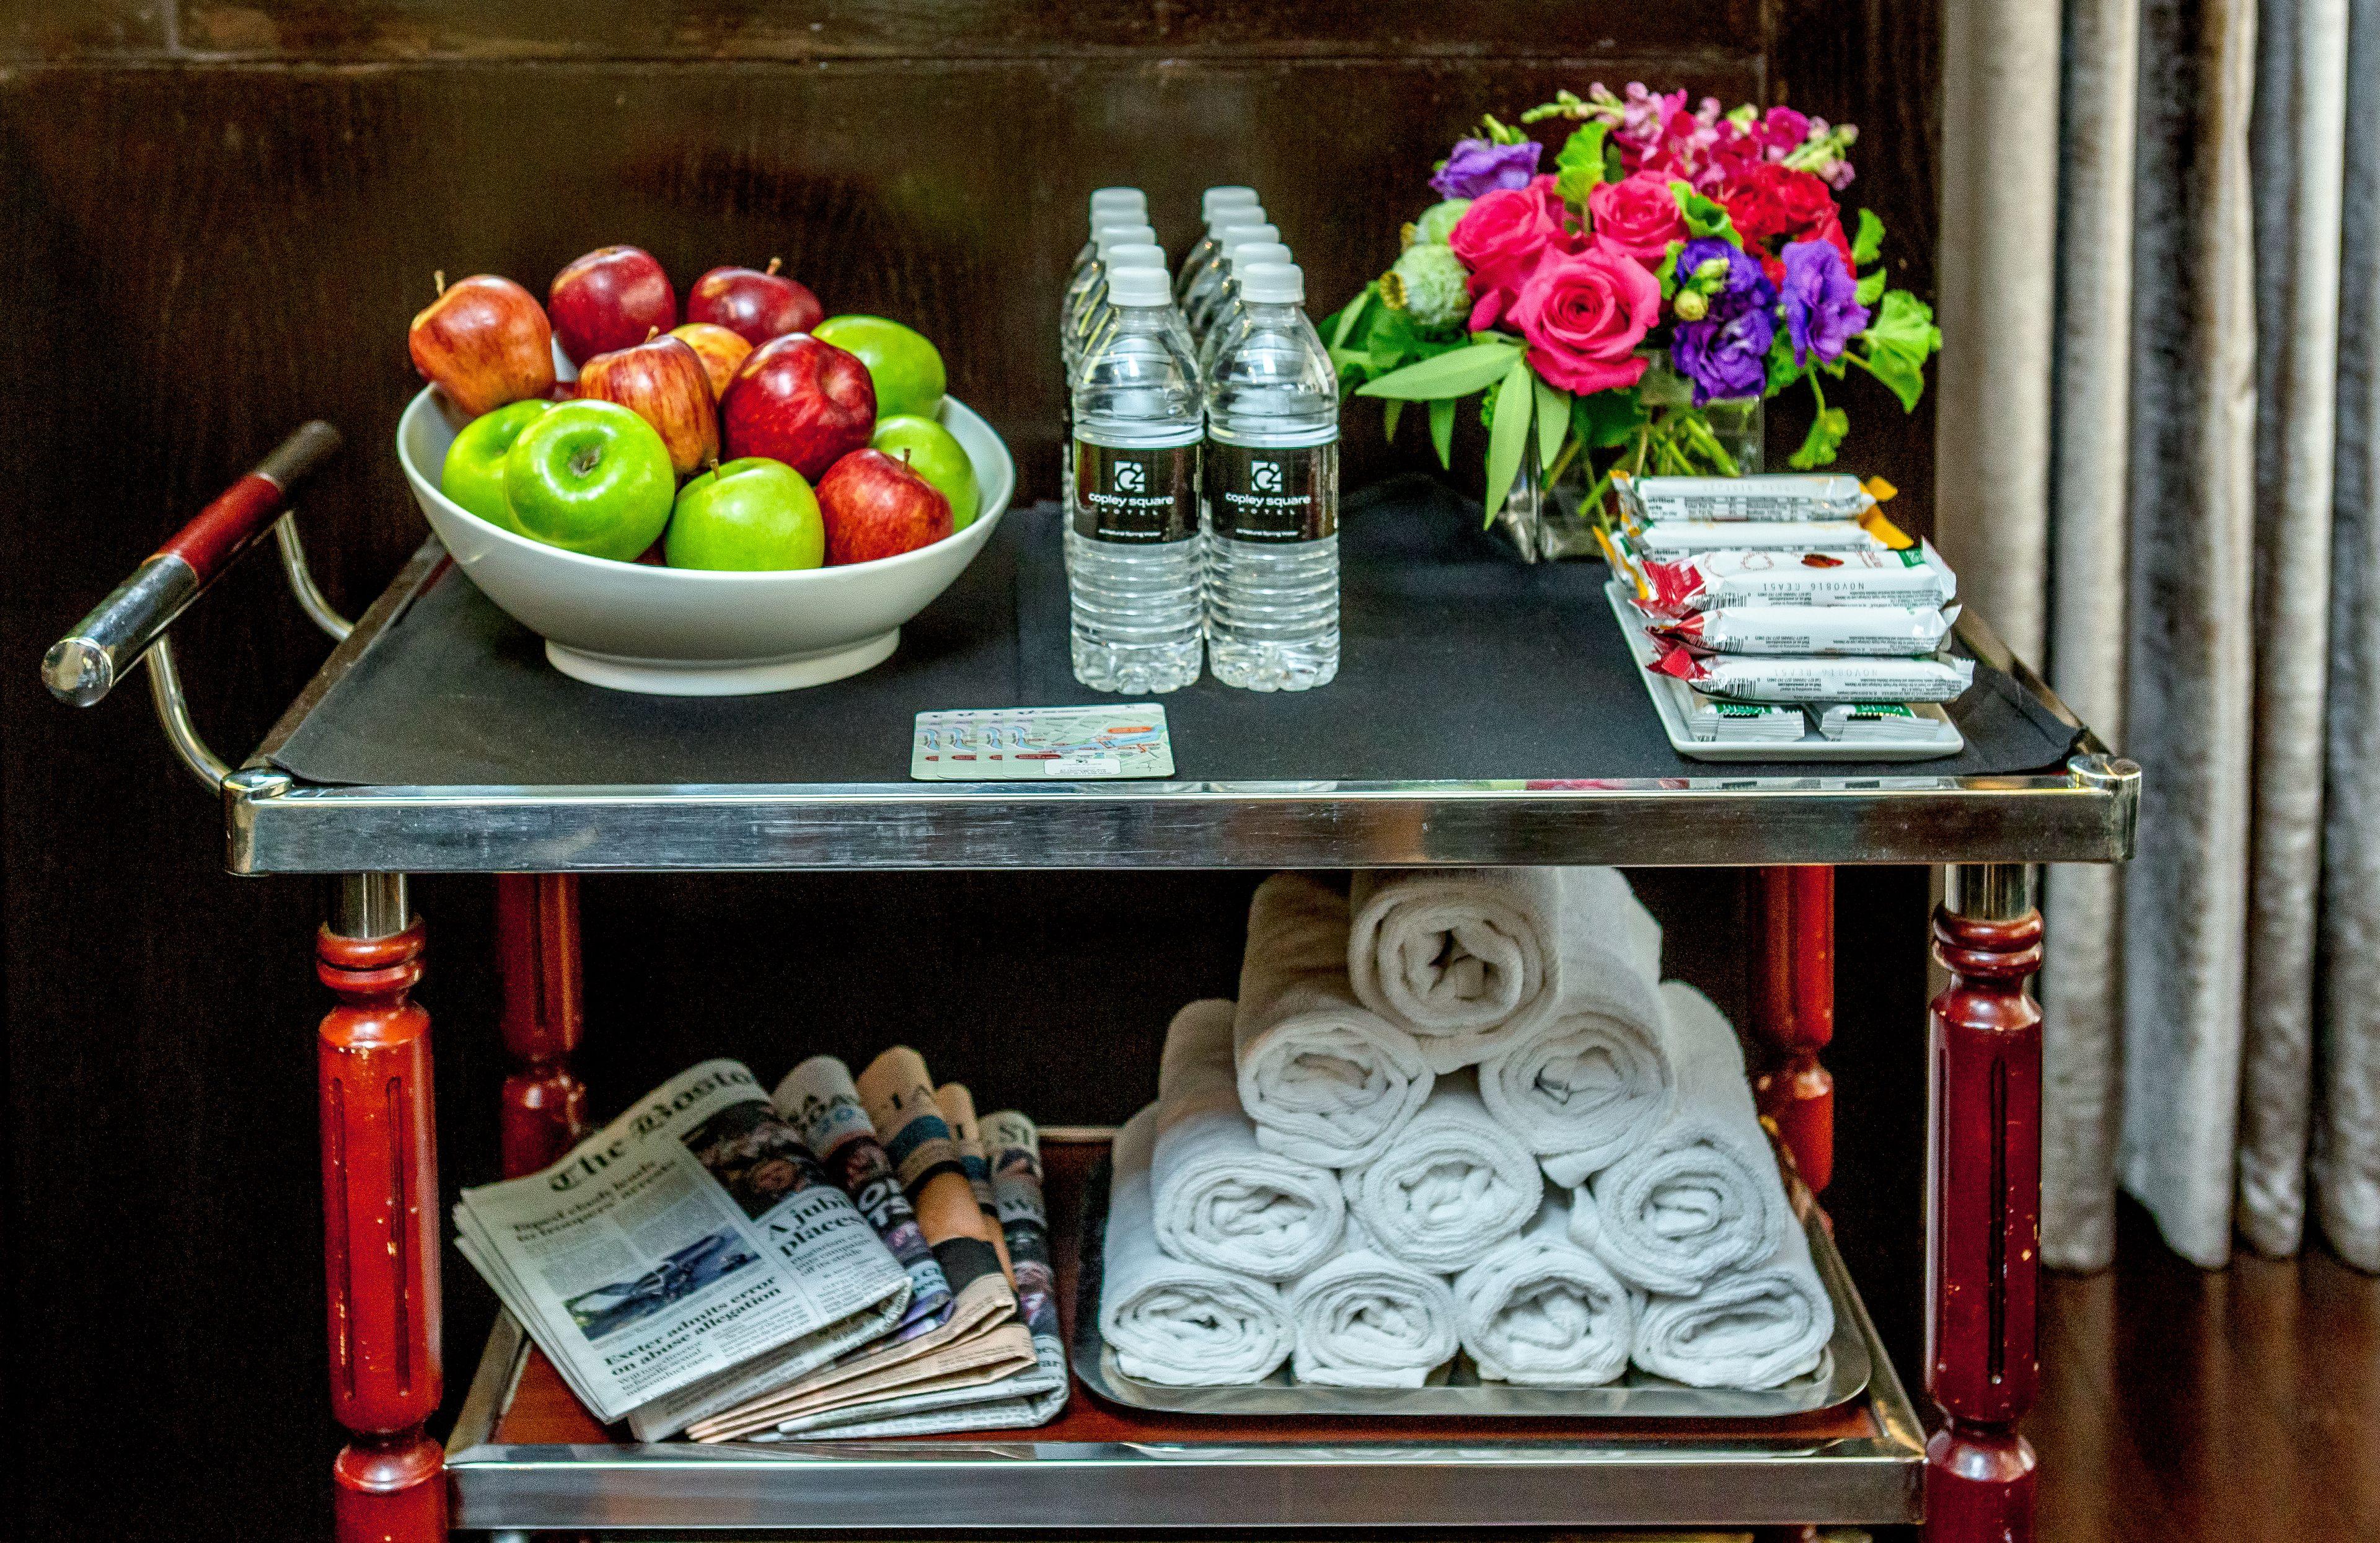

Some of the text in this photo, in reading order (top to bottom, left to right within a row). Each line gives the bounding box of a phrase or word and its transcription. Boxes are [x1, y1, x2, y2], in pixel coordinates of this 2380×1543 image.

[1088, 492, 1175, 508] copley square
[1225, 492, 1311, 508] copley square
[548, 1141, 624, 1193] The
[766, 1222, 790, 1242] A
[604, 1276, 775, 1367] Exeter admits error
[612, 1287, 781, 1376] on abuse allegation
